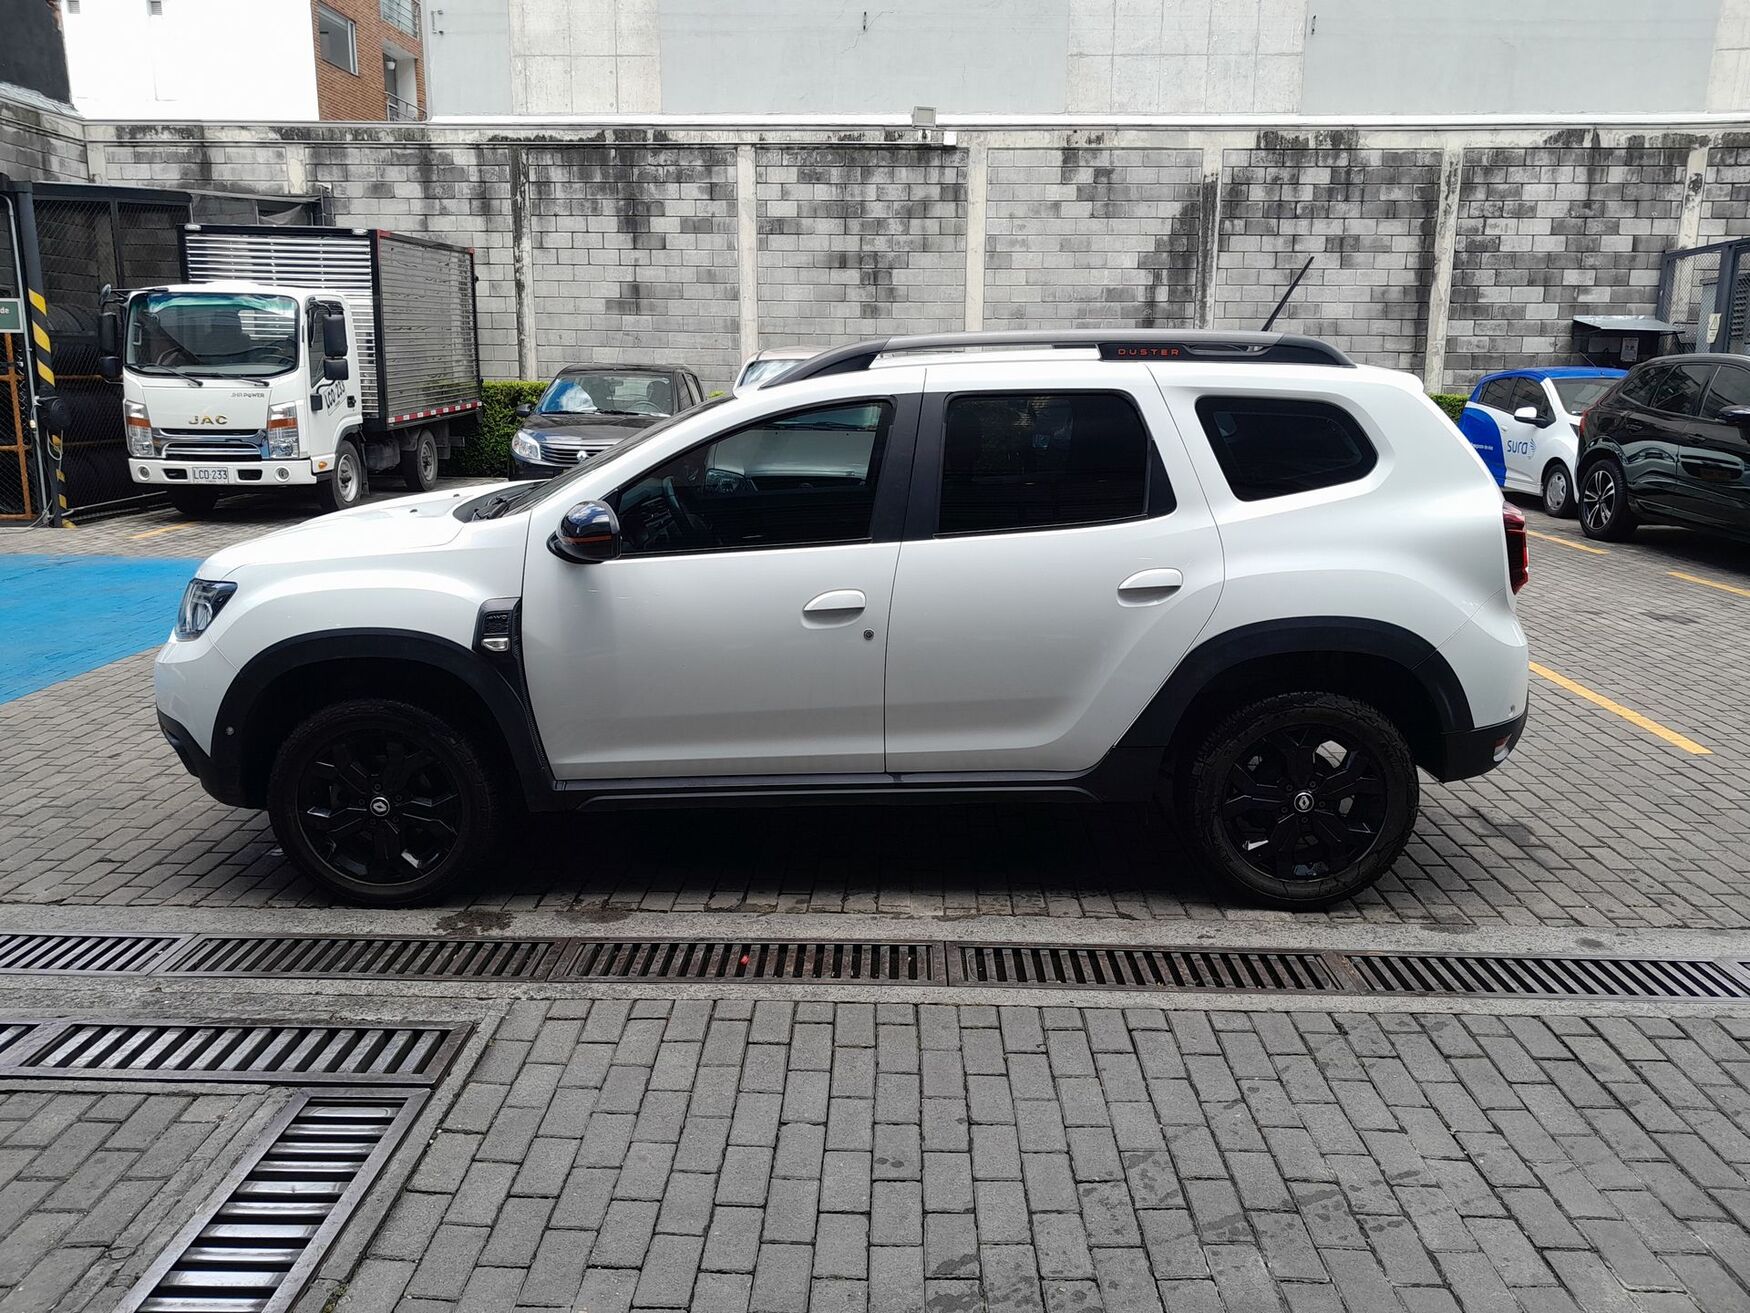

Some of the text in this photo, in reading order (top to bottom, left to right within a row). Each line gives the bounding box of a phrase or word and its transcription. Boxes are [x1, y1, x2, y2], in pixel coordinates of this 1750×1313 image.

[1118, 348, 1180, 356] DUSTER
[188, 415, 228, 425] JAC
[1507, 440, 1528, 454] sura
